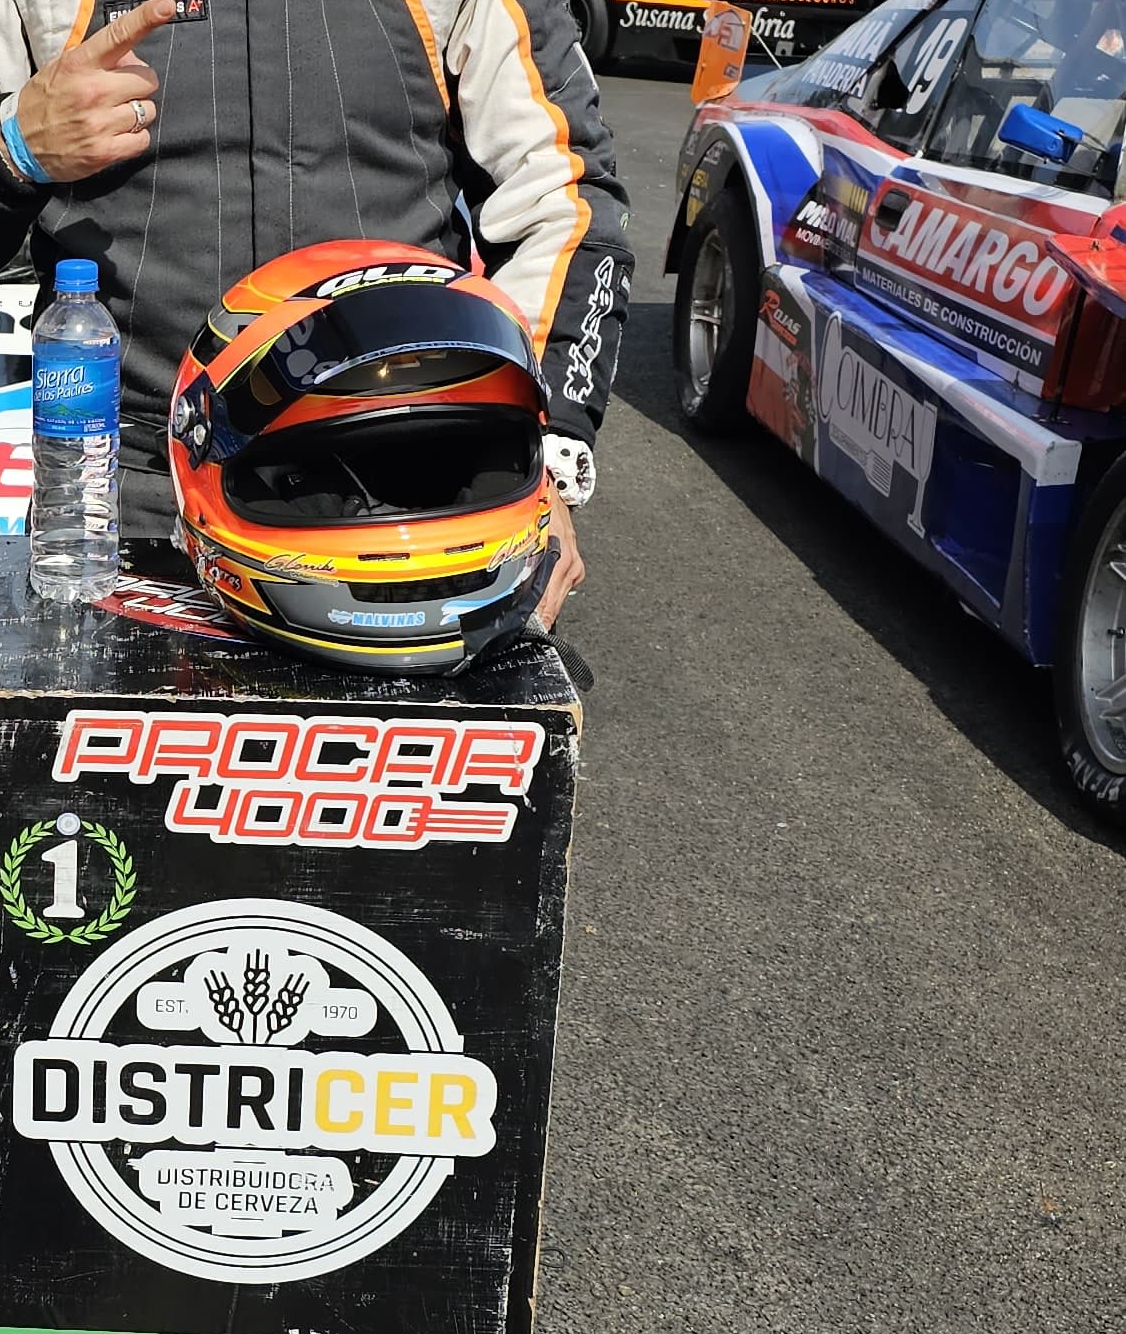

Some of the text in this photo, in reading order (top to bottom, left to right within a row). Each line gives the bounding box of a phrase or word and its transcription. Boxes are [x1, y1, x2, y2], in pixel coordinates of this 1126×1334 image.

[620, 2, 694, 31] Susana
[905, 18, 968, 115] 19
[861, 268, 1042, 367] MATERIALES DE CONSTRUCCIÓN
[36, 365, 85, 389] Sierra
[42, 390, 55, 401] los
[57, 381, 94, 399] Padres
[819, 312, 916, 470] COIMBRA
[352, 612, 425, 627] MALVINAS
[57, 715, 541, 791] PROCAR
[155, 998, 359, 1021] EST. 1970
[31, 1058, 479, 1140] DISTRICER
[157, 1169, 335, 1193] DISTRIBUIDORA
[179, 1192, 319, 1215] DE CERVEZA
